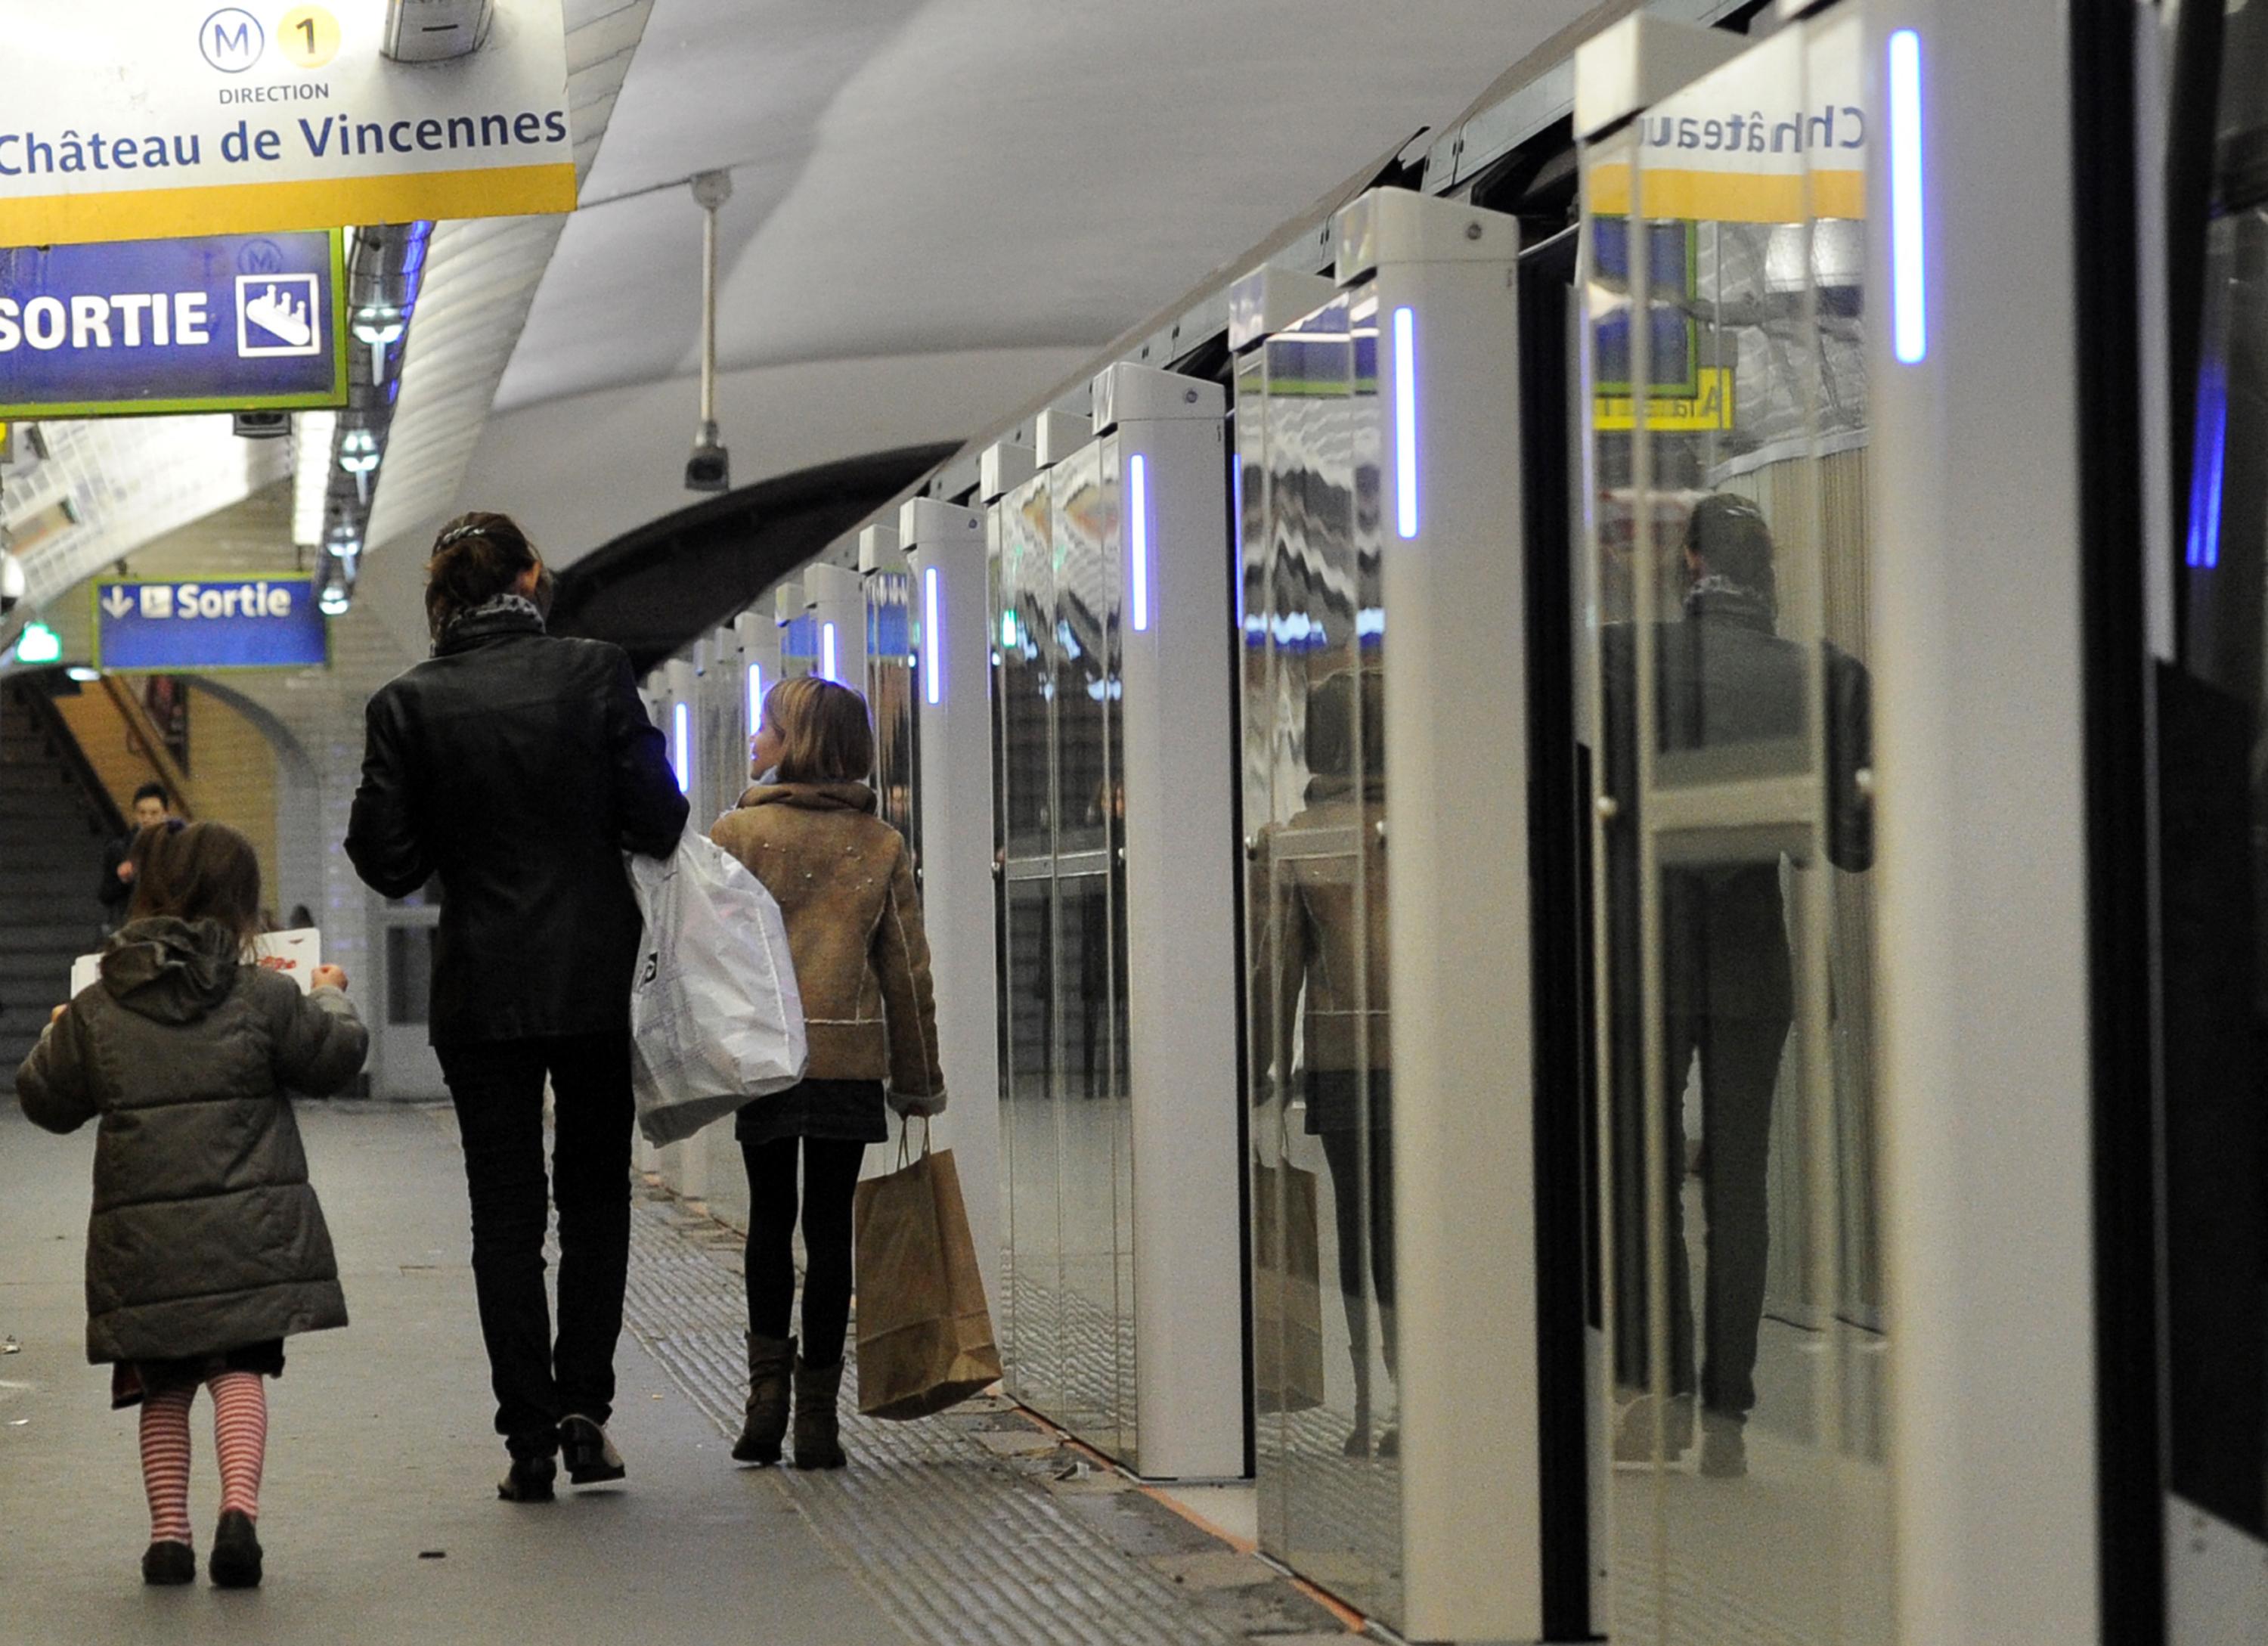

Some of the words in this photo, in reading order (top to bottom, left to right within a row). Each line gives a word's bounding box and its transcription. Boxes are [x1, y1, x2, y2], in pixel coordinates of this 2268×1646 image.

[296, 18, 315, 54] 1
[218, 83, 330, 104] DIRECTION
[0, 130, 200, 175] Château
[222, 120, 281, 163] de
[299, 110, 566, 157] Vincennes
[0, 292, 209, 352] SORTIE
[177, 581, 292, 619] Sortie
